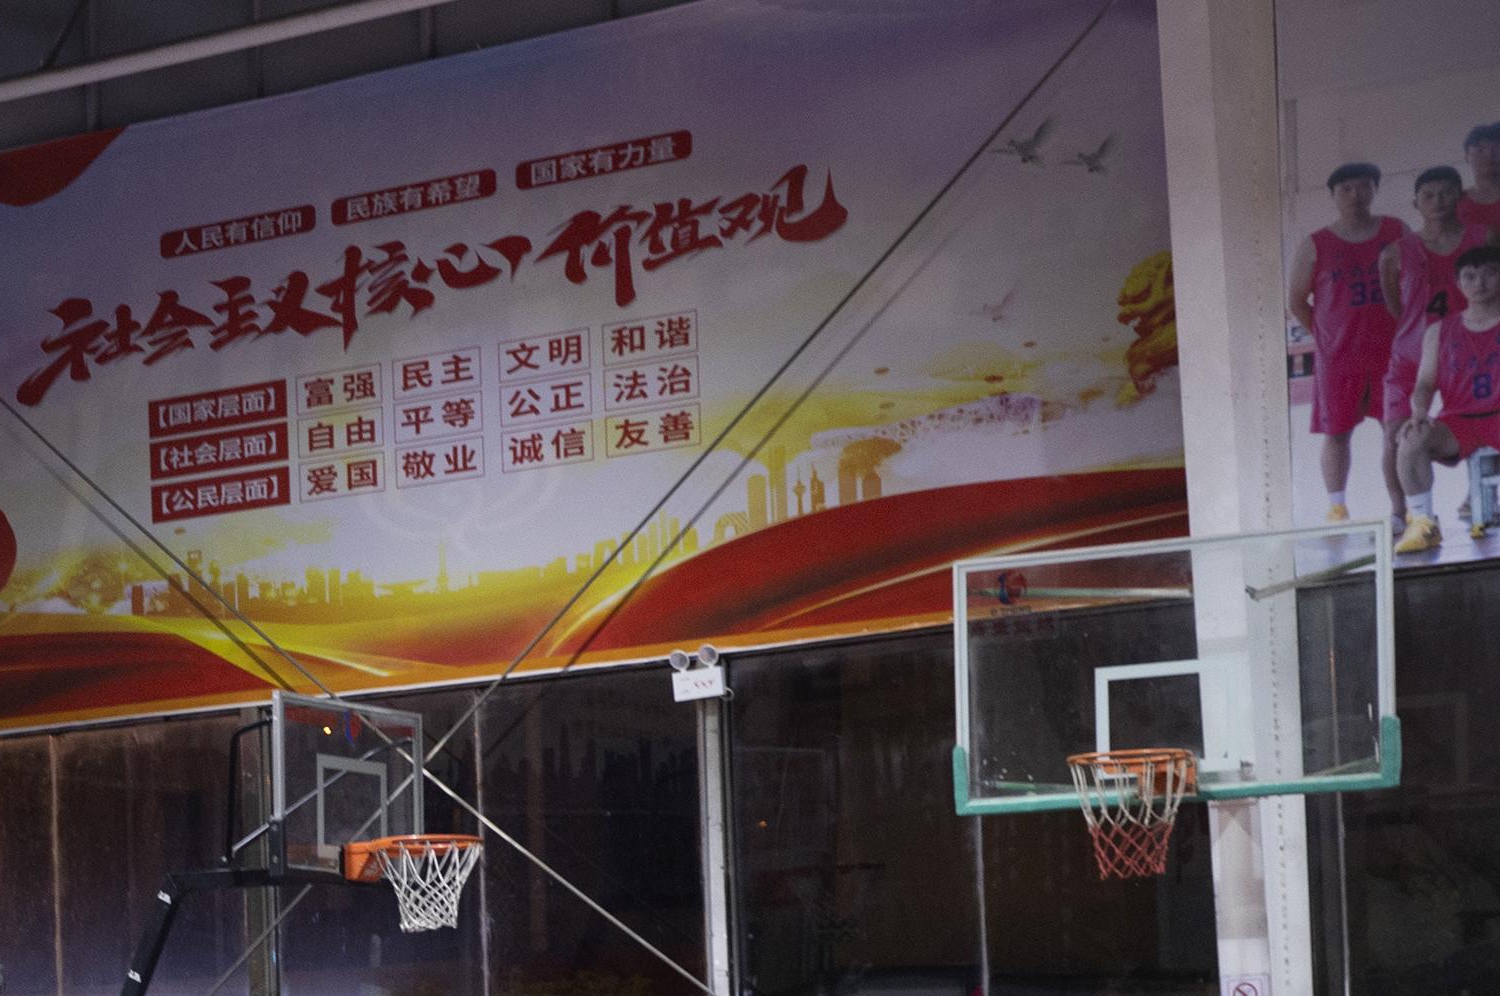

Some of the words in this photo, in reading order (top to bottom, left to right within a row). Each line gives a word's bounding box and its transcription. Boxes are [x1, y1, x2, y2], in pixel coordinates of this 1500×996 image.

[346, 174, 481, 222] 民族有希望
[530, 135, 678, 187] 国家有力量
[174, 210, 302, 255] 人民有信仰
[15, 164, 849, 406] 社会主义核心价值观
[303, 369, 377, 407] 富强
[401, 354, 475, 391] 民主
[505, 334, 583, 374] 文明
[611, 316, 692, 356] 和谐
[307, 416, 377, 450] 自由
[401, 399, 476, 436] 平等
[508, 381, 585, 419] 公正
[612, 364, 693, 402] 法治
[307, 459, 378, 497] 爱国
[402, 445, 477, 481] 敬业
[508, 427, 587, 466] 诚信
[614, 411, 695, 450] 友善
